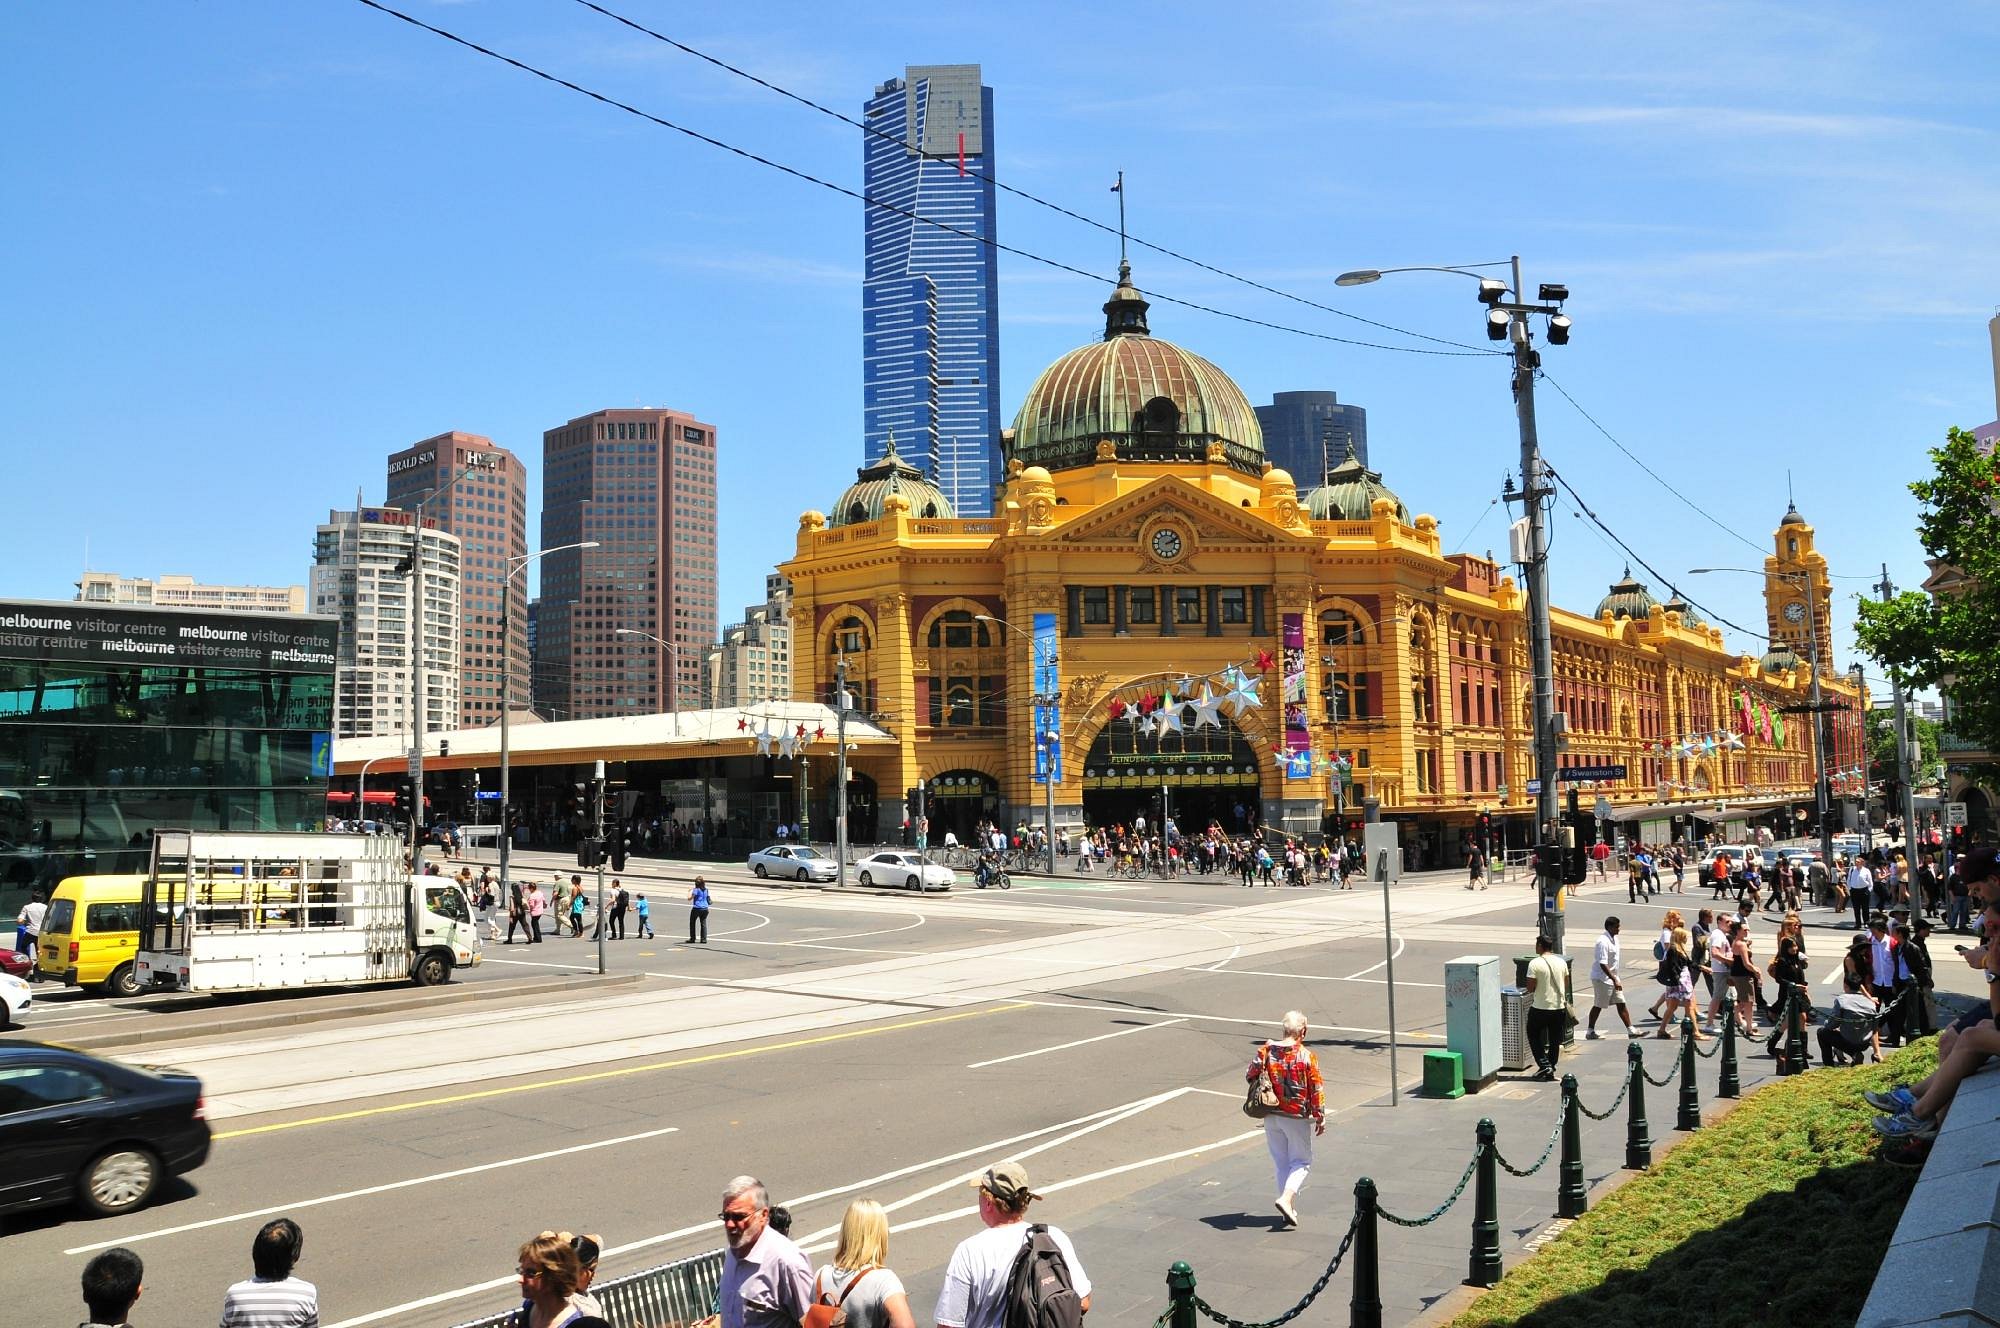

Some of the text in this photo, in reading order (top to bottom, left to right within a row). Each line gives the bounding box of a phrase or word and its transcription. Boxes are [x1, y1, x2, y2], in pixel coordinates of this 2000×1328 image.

[387, 449, 435, 474] HERALD SUN
[76, 618, 121, 633] visitor
[124, 624, 167, 636] centre
[179, 626, 248, 641] melbourne
[251, 630, 291, 644] visitor
[293, 635, 330, 648] centre
[0, 632, 335, 664] isitor centre melbourne visitor centre melbourne
[1571, 768, 1624, 777] Swanston St
